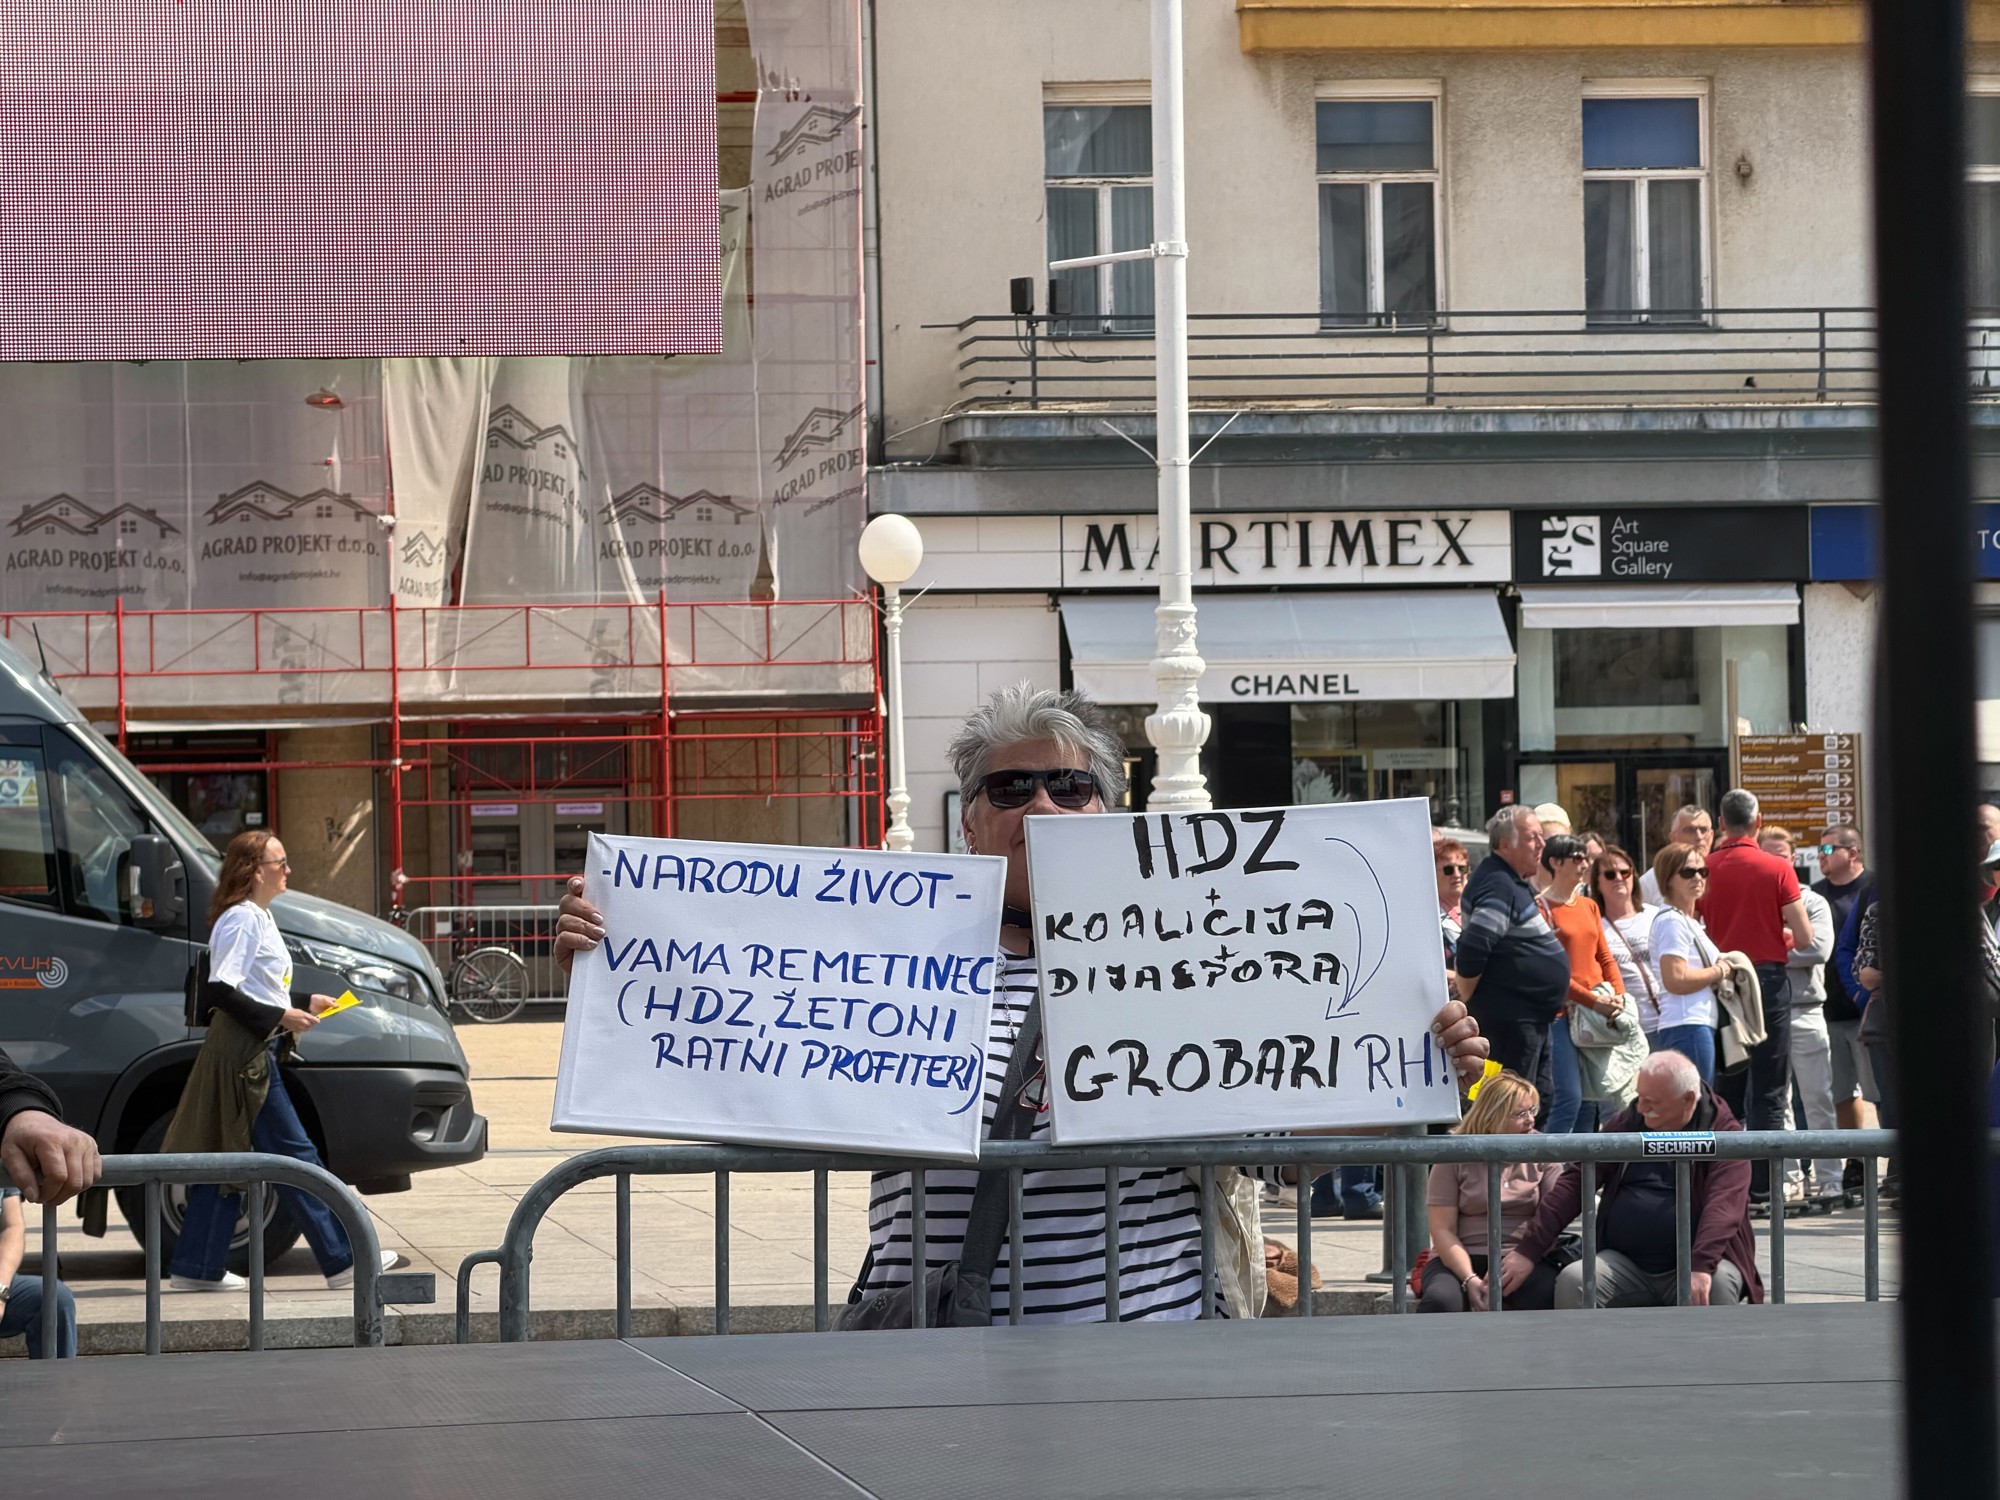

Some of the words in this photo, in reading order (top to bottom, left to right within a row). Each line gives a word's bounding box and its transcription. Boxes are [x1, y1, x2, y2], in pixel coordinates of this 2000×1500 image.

[765, 167, 812, 203] AGRAD
[508, 465, 565, 497] PROJEKT
[773, 468, 816, 509] AGRAD
[1611, 516, 1639, 534] Art
[201, 536, 257, 561] AGRAD
[263, 534, 332, 556] PROJEKT
[338, 538, 380, 557] d.o.o.
[648, 538, 713, 559] PROJEKT
[718, 540, 755, 558] d.o.o.
[1080, 518, 1474, 575] MRTIMEX
[1611, 534, 1669, 557] Square
[6, 549, 64, 571] AGRAD
[69, 550, 138, 572] PROJEKT
[143, 551, 185, 574] d.o.o.
[1611, 556, 1673, 579] Gallery
[1231, 674, 1359, 696] CHANEL
[1132, 809, 1300, 880] HDZ
[603, 936, 729, 976] VAMA
[742, 943, 993, 996] REMETINEC
[651, 1032, 789, 1078] RATNI
[1064, 1034, 1341, 1103] GROBARI
[1648, 1140, 1713, 1154] SECURITY
